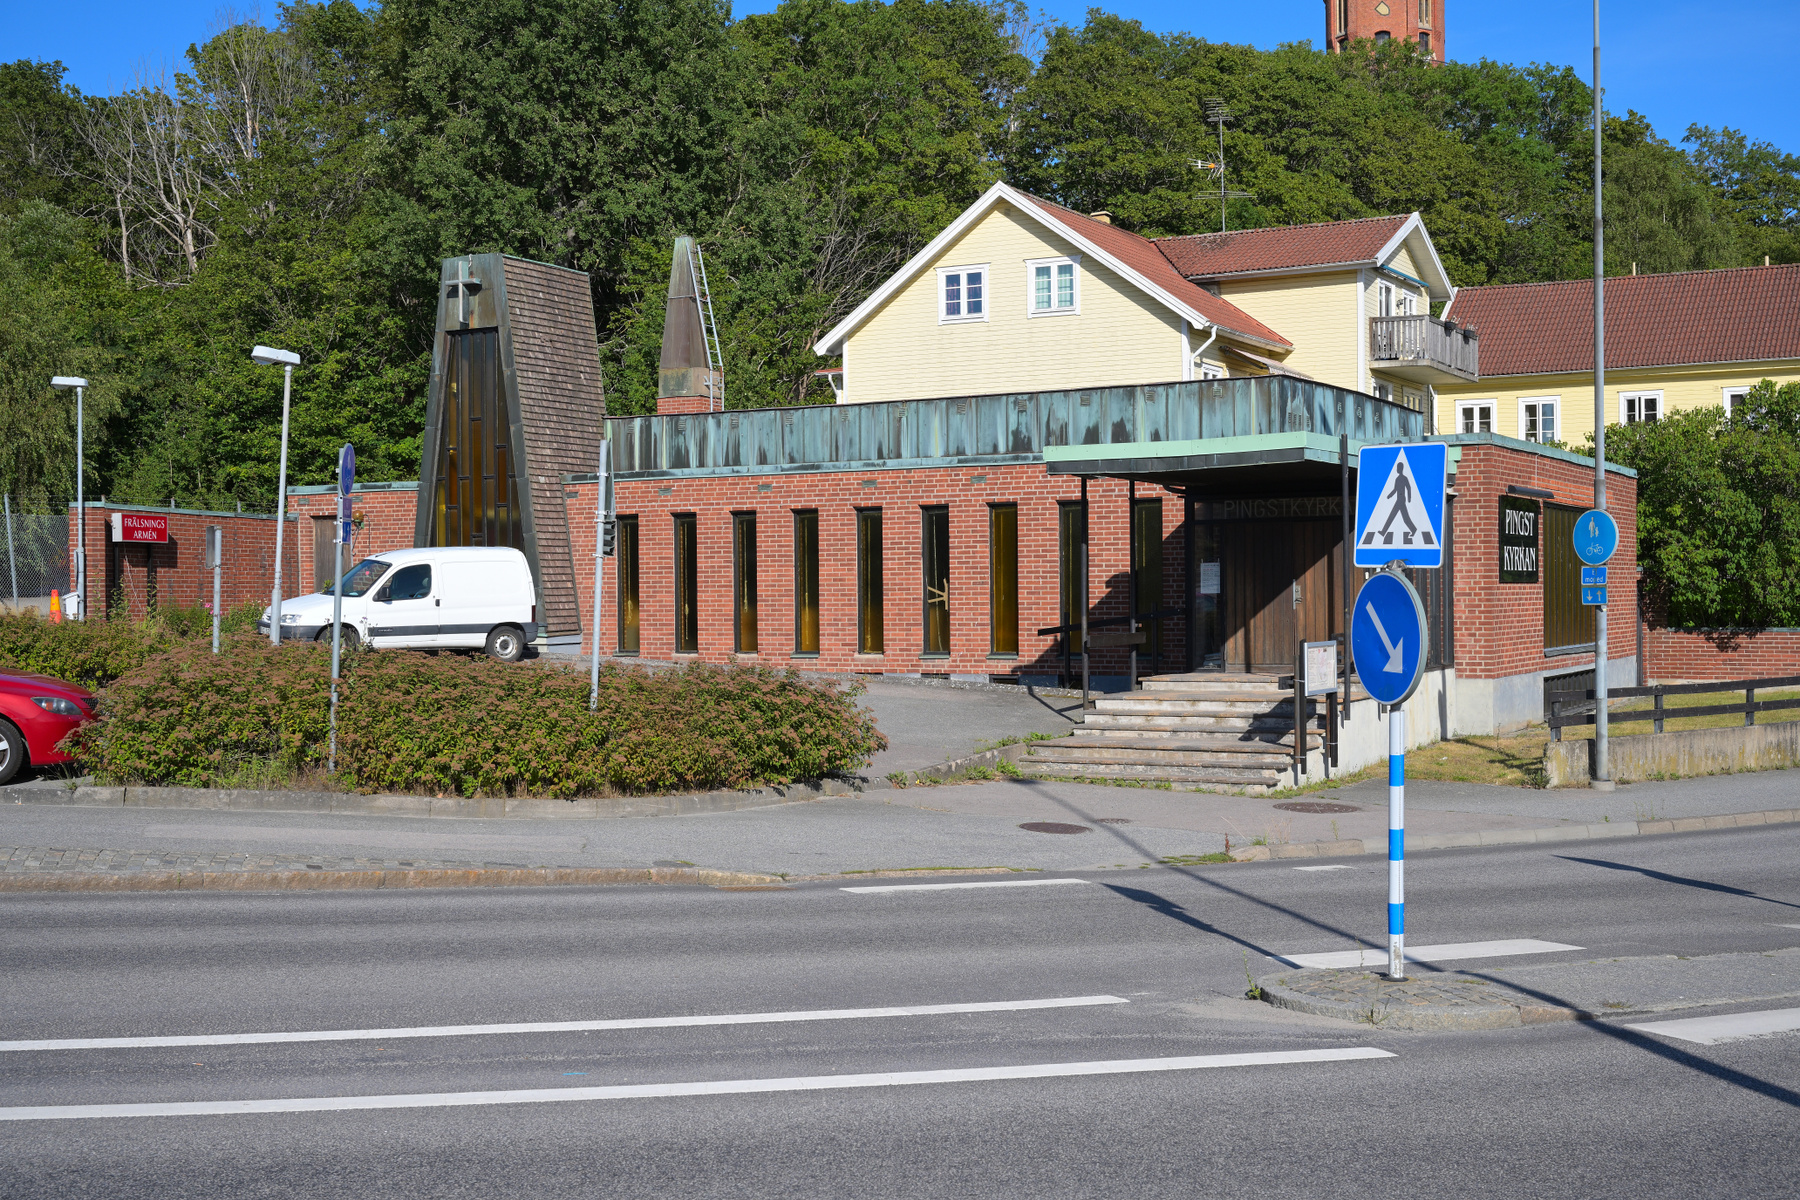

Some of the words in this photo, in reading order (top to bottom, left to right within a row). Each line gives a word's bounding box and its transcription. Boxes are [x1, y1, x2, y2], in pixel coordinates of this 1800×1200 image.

[124, 517, 165, 529] FRÄLSNINGS
[1505, 509, 1535, 536] PINGST
[133, 529, 157, 540] ARMÉN
[1504, 545, 1536, 571] KYRKAN
